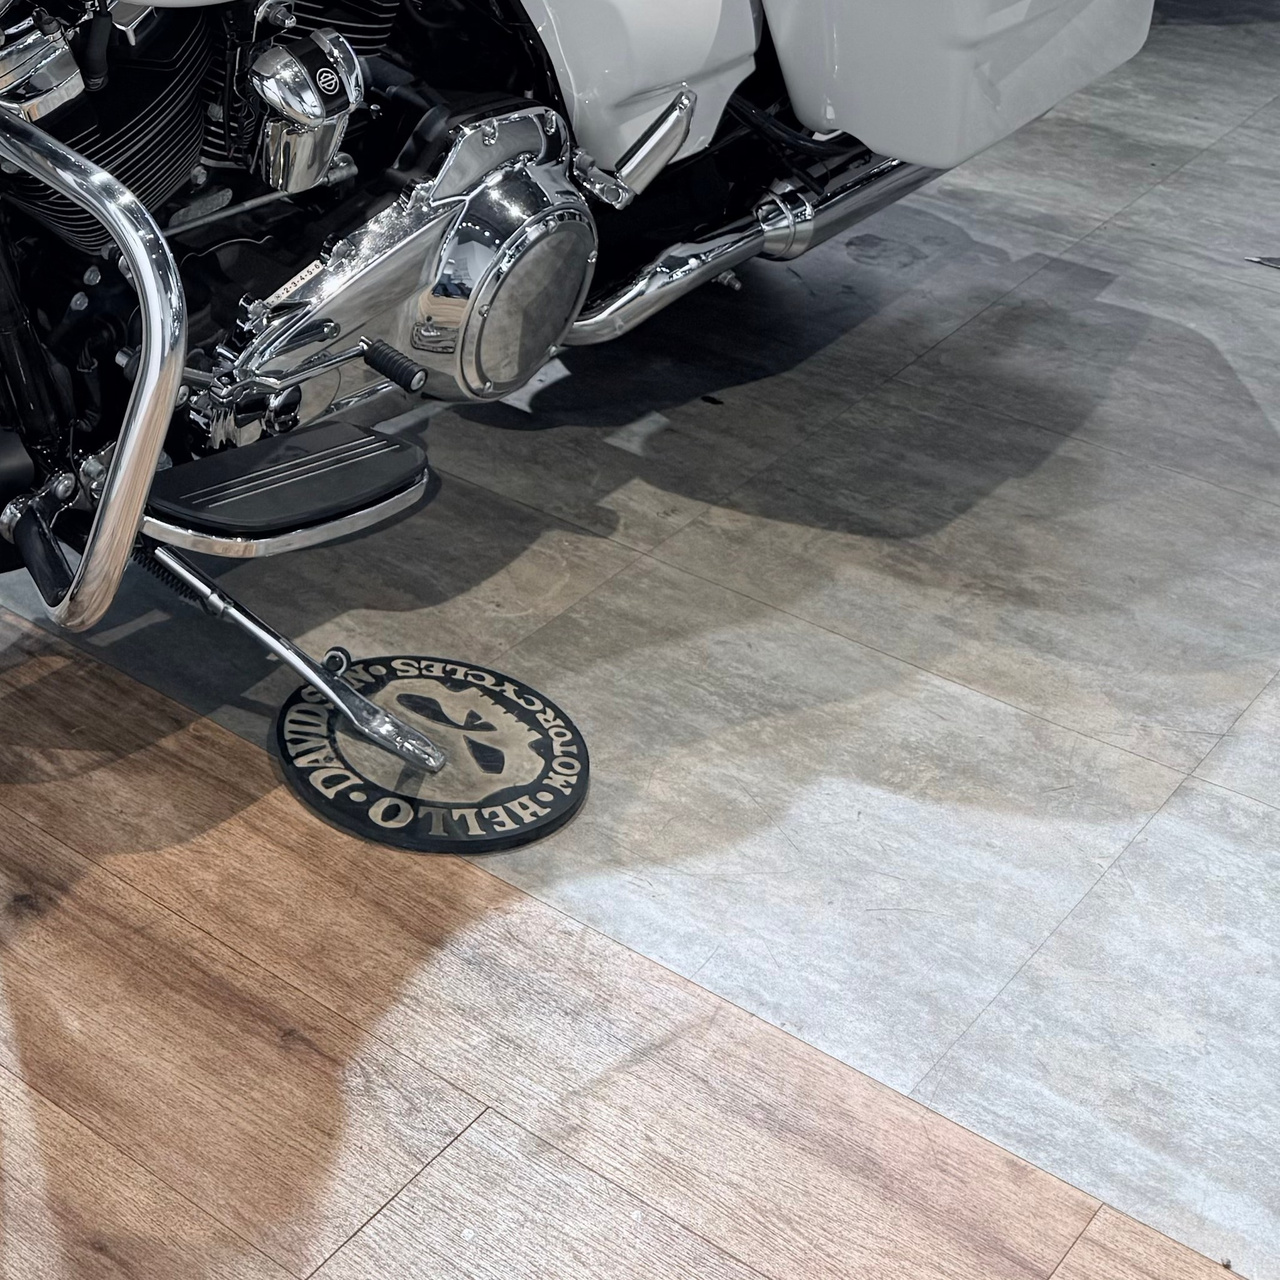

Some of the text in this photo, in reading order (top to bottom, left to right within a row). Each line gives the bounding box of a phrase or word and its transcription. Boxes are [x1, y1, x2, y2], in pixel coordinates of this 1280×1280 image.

[283, 664, 375, 800] DAVIDSN
[391, 658, 581, 796] MOTORCYCLES
[368, 794, 552, 836] HELLO
